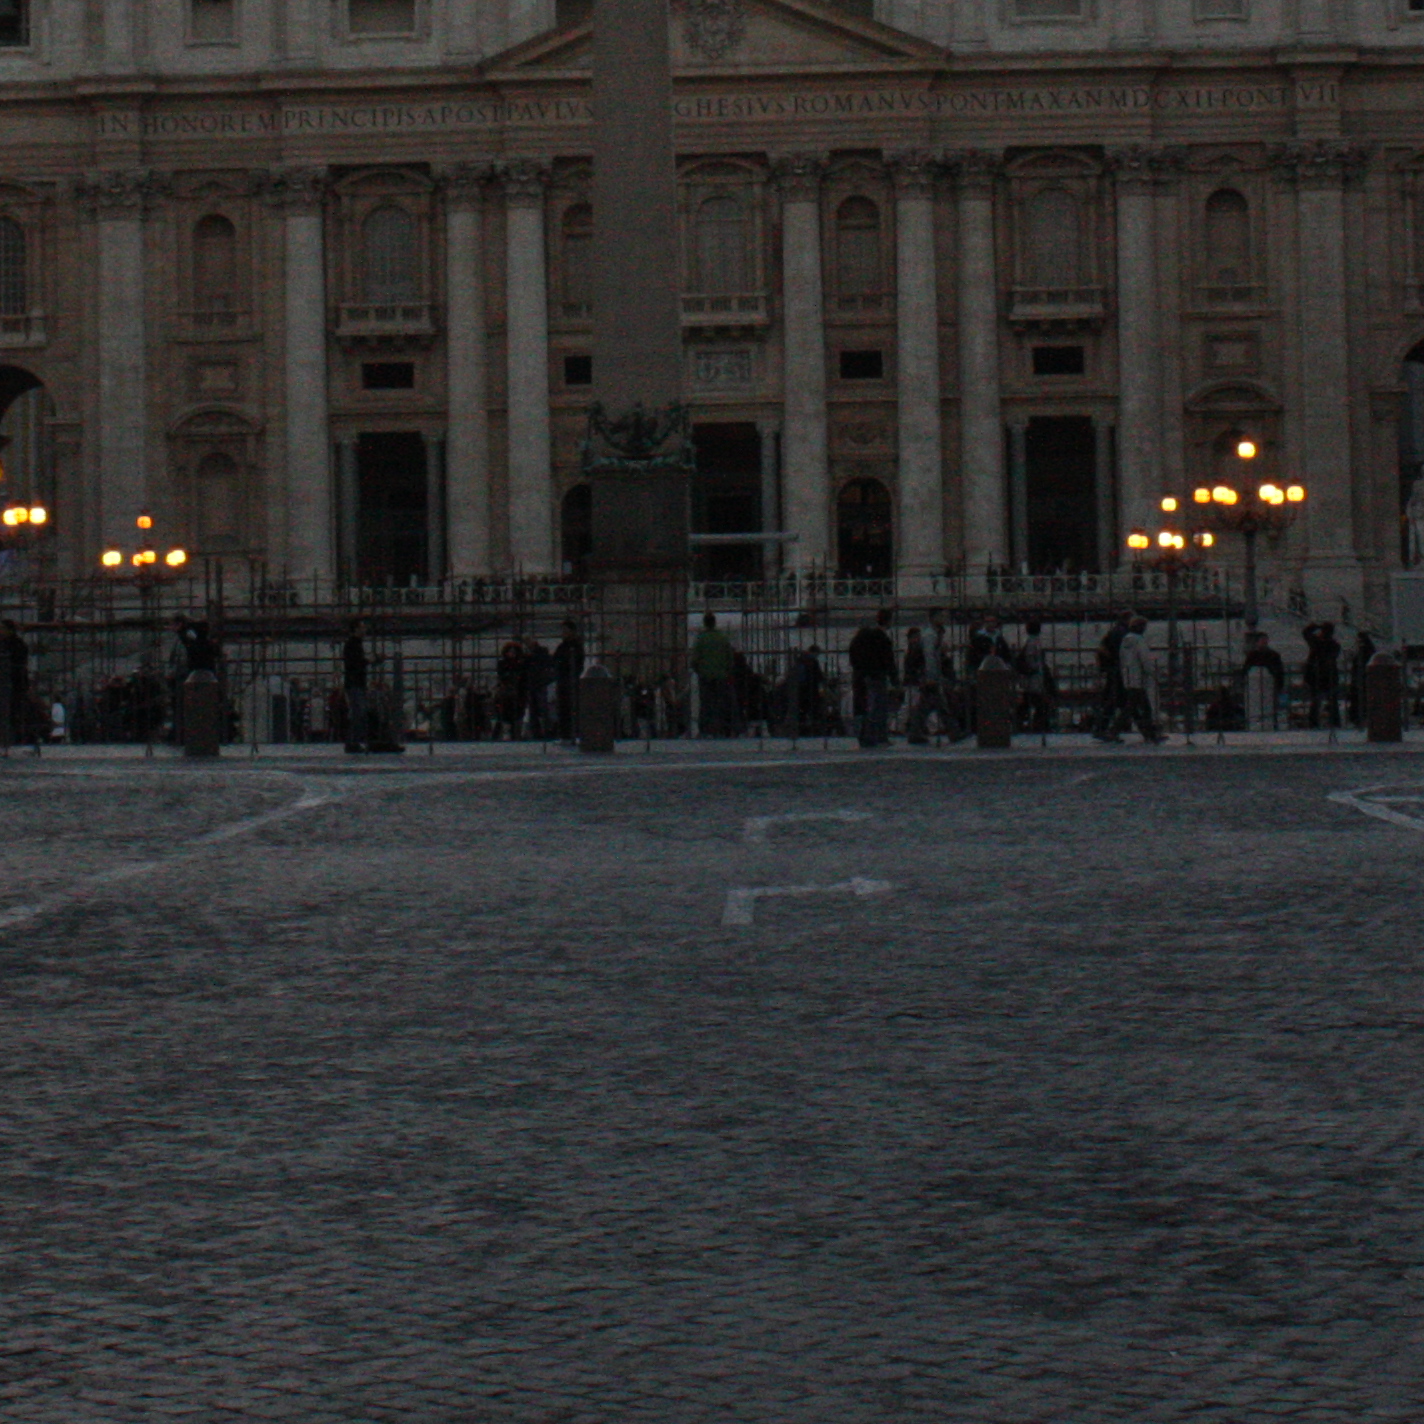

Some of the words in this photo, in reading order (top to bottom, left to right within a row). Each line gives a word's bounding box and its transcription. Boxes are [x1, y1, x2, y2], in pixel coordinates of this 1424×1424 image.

[98, 113, 128, 134] IN
[140, 112, 275, 134] HONOREM
[284, 107, 416, 129] PRINCIPIS
[504, 98, 595, 123] PAVLVS
[793, 92, 929, 114] ROMANVS
[935, 90, 1000, 112] PONT
[1006, 90, 1063, 111] MAX
[1221, 87, 1287, 108] PONT
[1297, 83, 1337, 103] VII
